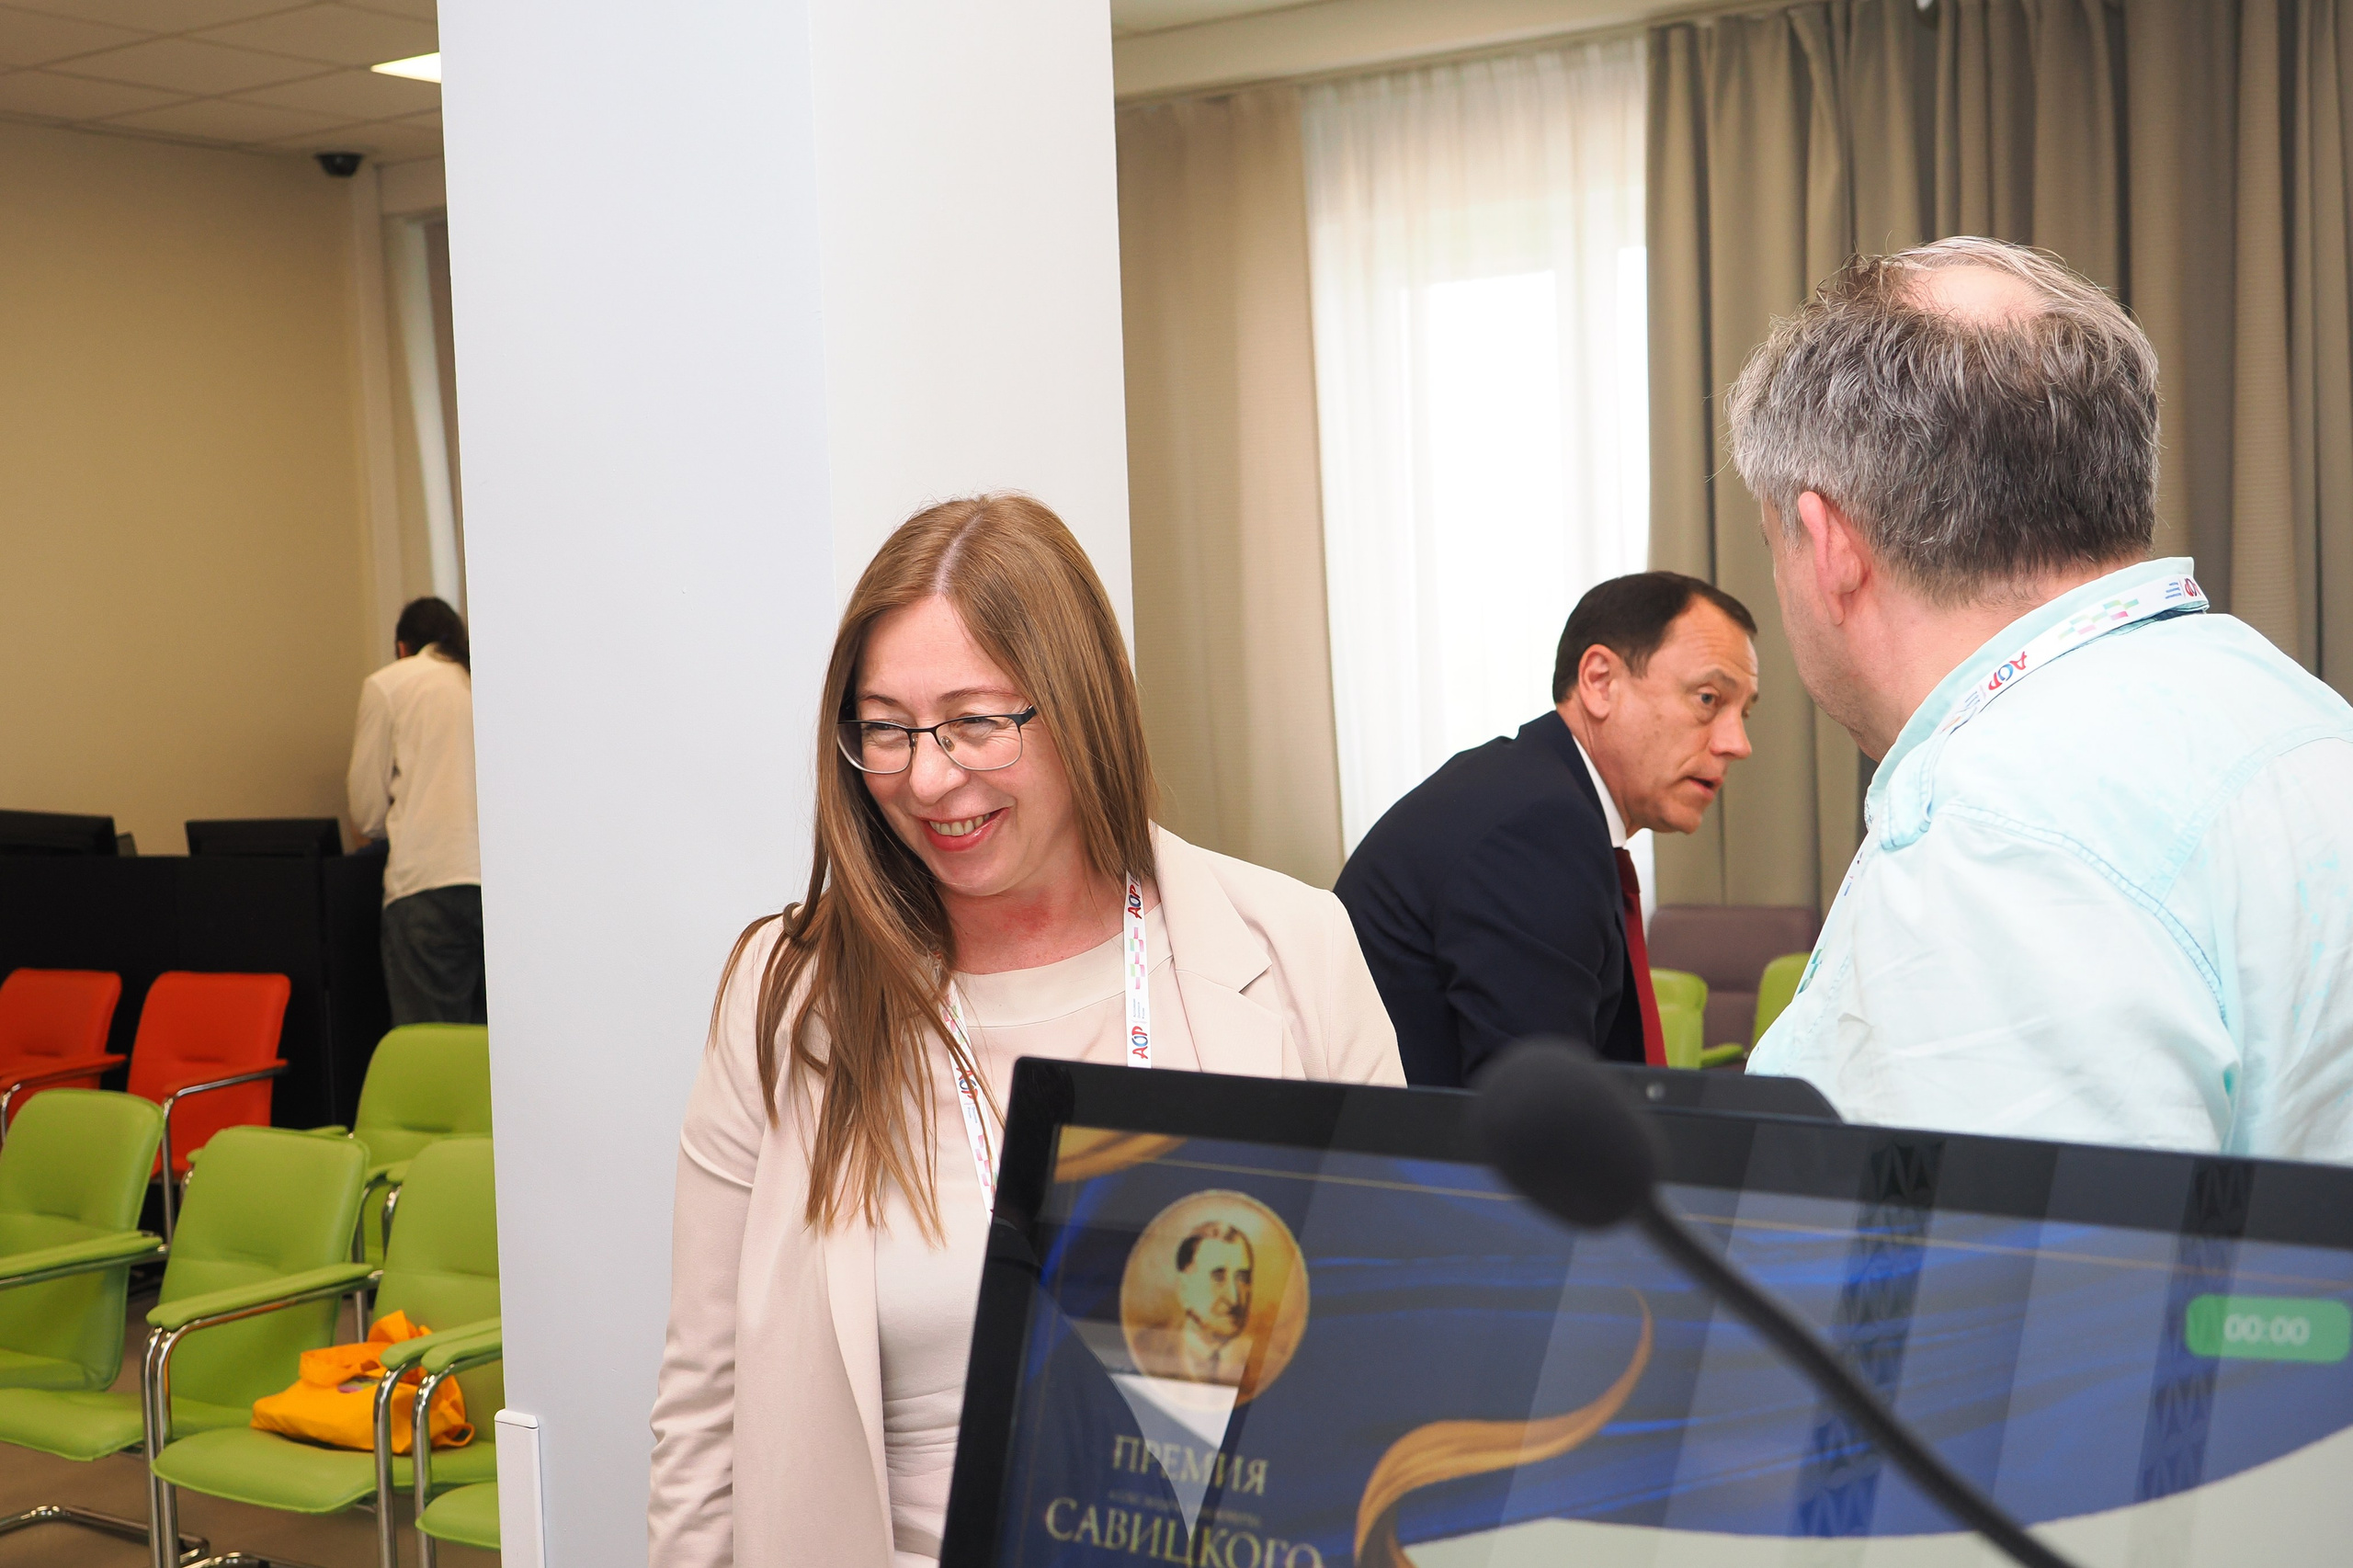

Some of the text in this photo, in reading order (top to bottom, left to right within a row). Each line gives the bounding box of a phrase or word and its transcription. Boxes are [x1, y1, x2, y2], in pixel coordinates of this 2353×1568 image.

[2223, 1313, 2311, 1346] 00:00
[1112, 1435, 1268, 1496] ПРЕМИЯ
[1044, 1496, 1324, 1568] САВИЦКОГО
